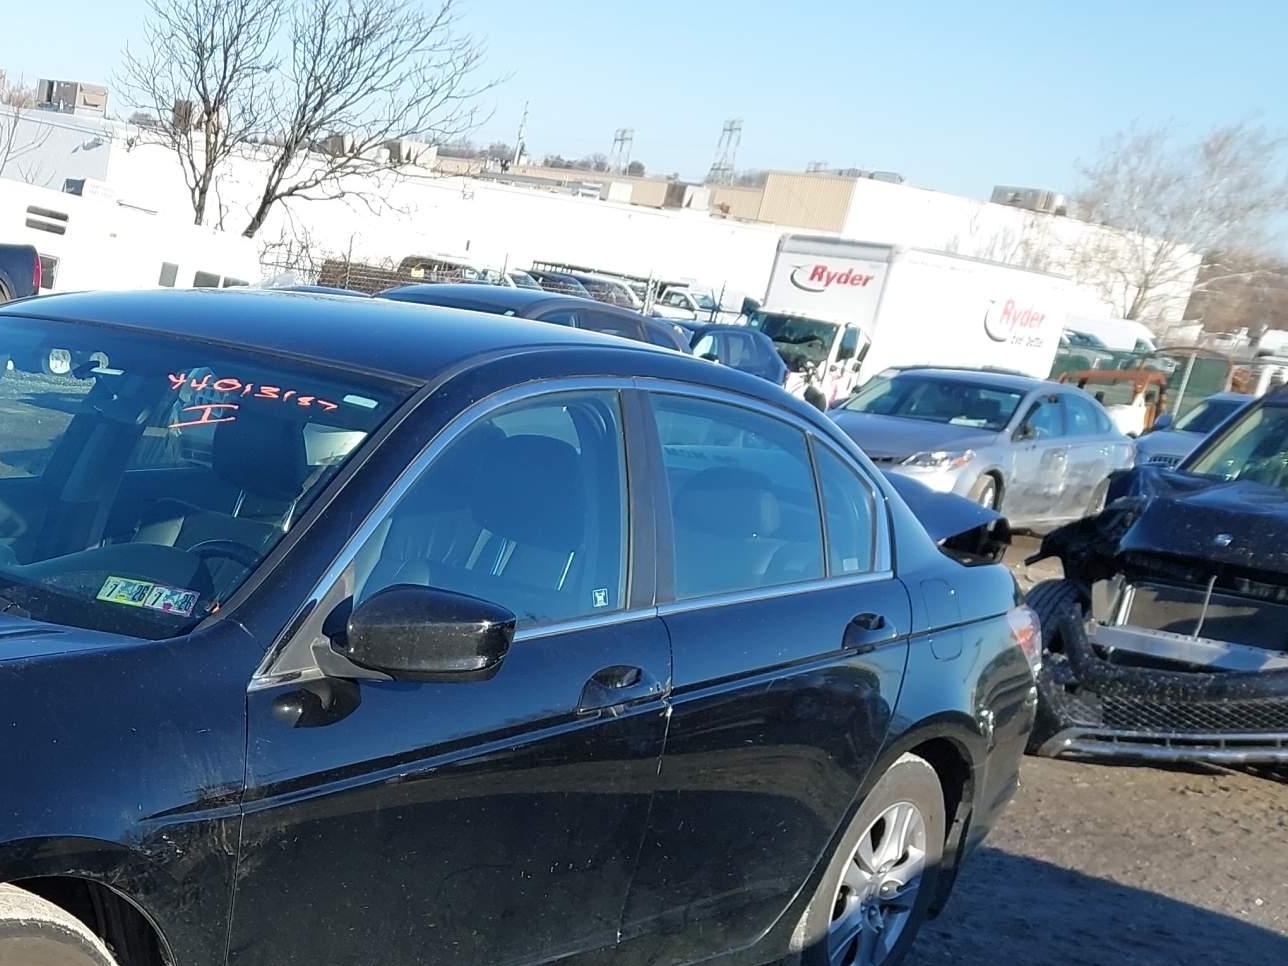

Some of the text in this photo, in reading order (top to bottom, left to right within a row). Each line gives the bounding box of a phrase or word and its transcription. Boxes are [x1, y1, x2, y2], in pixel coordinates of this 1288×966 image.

[809, 264, 875, 288] Ryder
[1000, 297, 1047, 332] Ryder
[167, 372, 339, 412] 44013187
[106, 583, 150, 602] 7 26
[152, 591, 163, 606] 7
